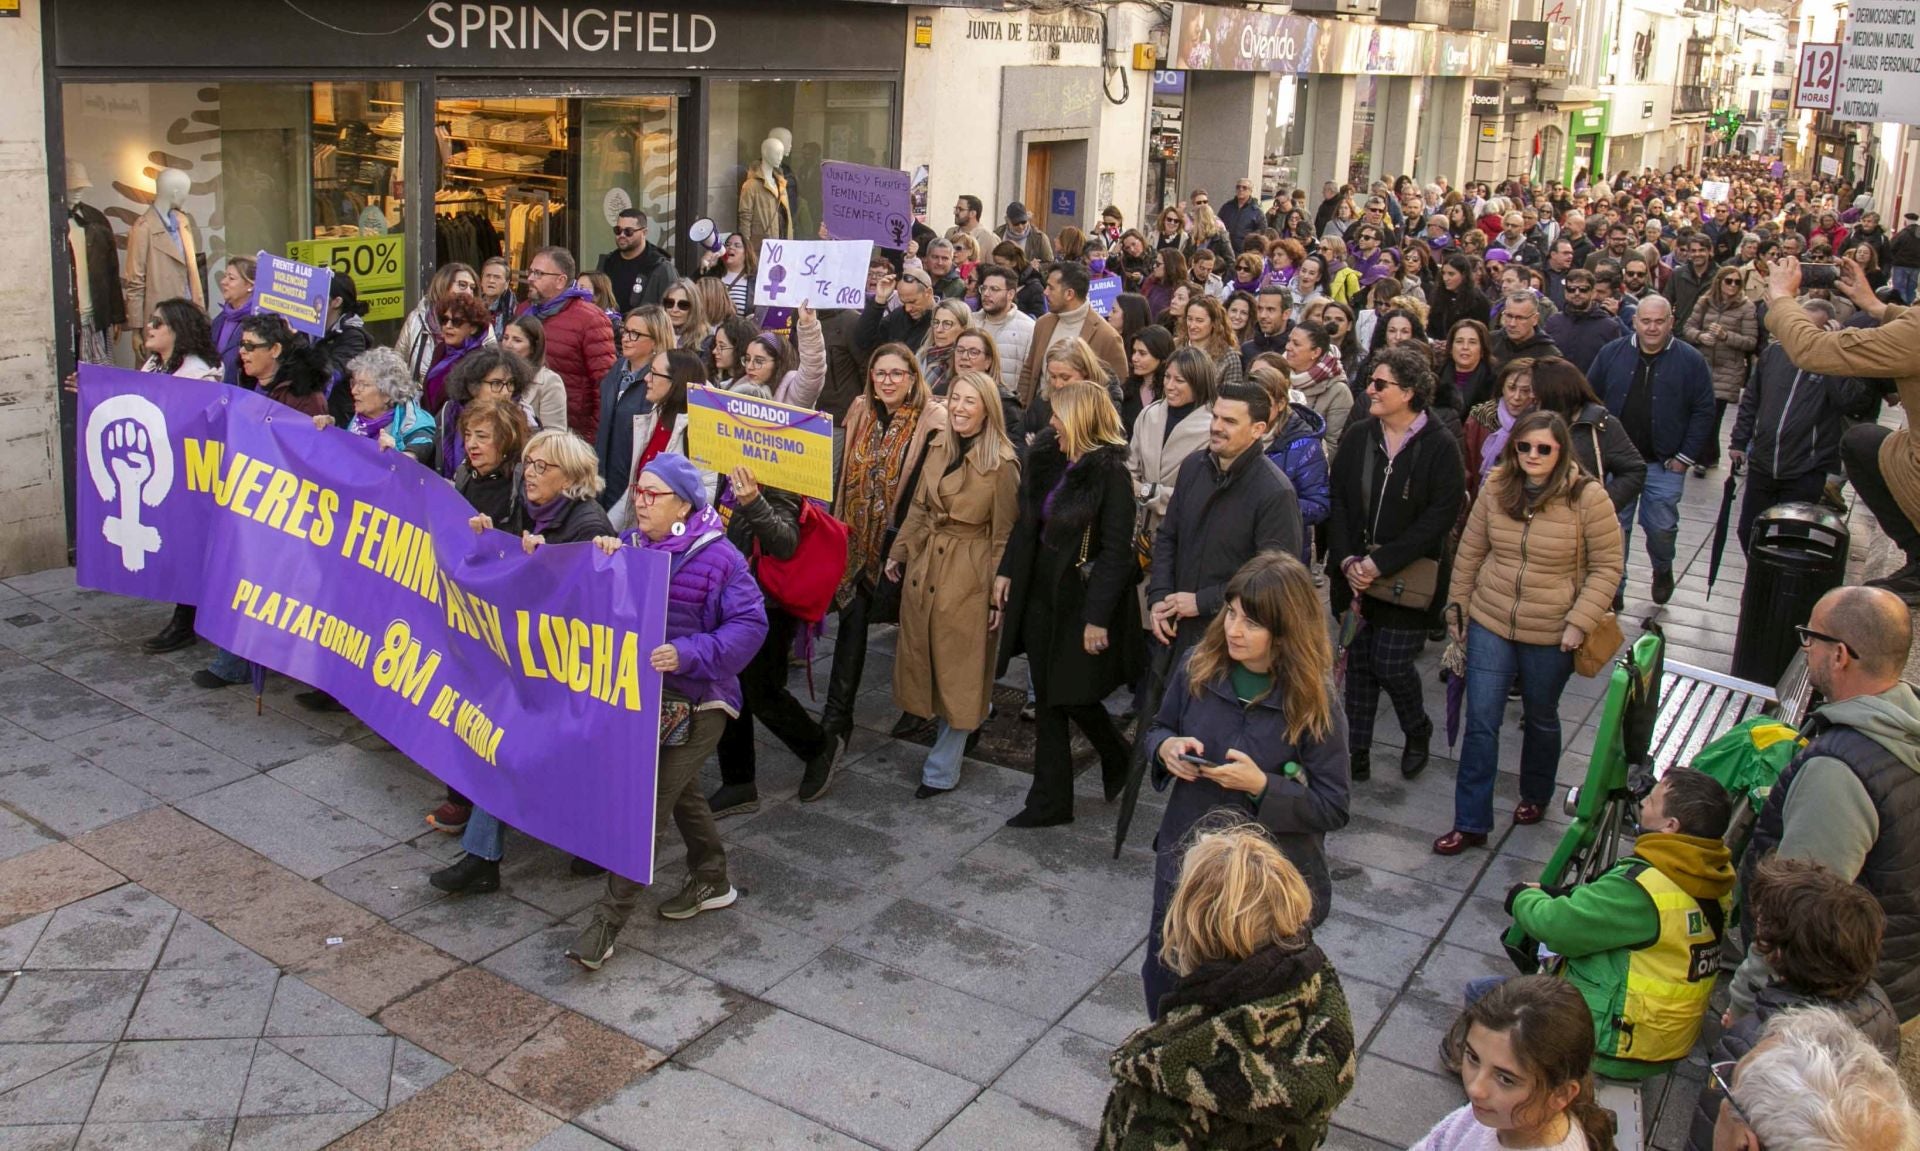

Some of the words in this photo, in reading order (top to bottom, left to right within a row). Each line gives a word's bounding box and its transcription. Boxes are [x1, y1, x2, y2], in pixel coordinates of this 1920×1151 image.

[426, 2, 717, 53] SPRINGFIELD
[966, 20, 1003, 40] JUNTA
[1008, 22, 1022, 41] DE
[1028, 23, 1100, 45] EXTREMADURA
[1853, 31, 1883, 47] MEDICINA
[1885, 32, 1914, 49] NATURAL
[1803, 50, 1834, 90] 12
[1846, 77, 1883, 95] ORTOPEDIA
[1801, 92, 1829, 103] HORAS
[864, 174, 871, 186] Y
[831, 185, 890, 208] FEMINISTAS
[833, 203, 883, 225] SIEMPRE
[766, 242, 783, 264] YO
[272, 258, 295, 273] FRENTE
[295, 264, 300, 275] A
[300, 265, 313, 278] LAS
[815, 280, 832, 297] TE
[835, 286, 862, 304] CREO
[1089, 281, 1116, 291] LARIAL
[376, 295, 400, 305] TODO
[727, 399, 790, 425] ¡CUIDADO!
[717, 422, 731, 437] EL
[734, 427, 805, 455] MACHISMO
[742, 444, 779, 463] MATA
[184, 438, 339, 547] MJERES
[516, 610, 641, 711] LUCHA
[231, 578, 371, 670] PLATAFORMA
[373, 618, 442, 706] 8M
[428, 684, 460, 727] DE
[454, 699, 505, 766] MÉRIDA
